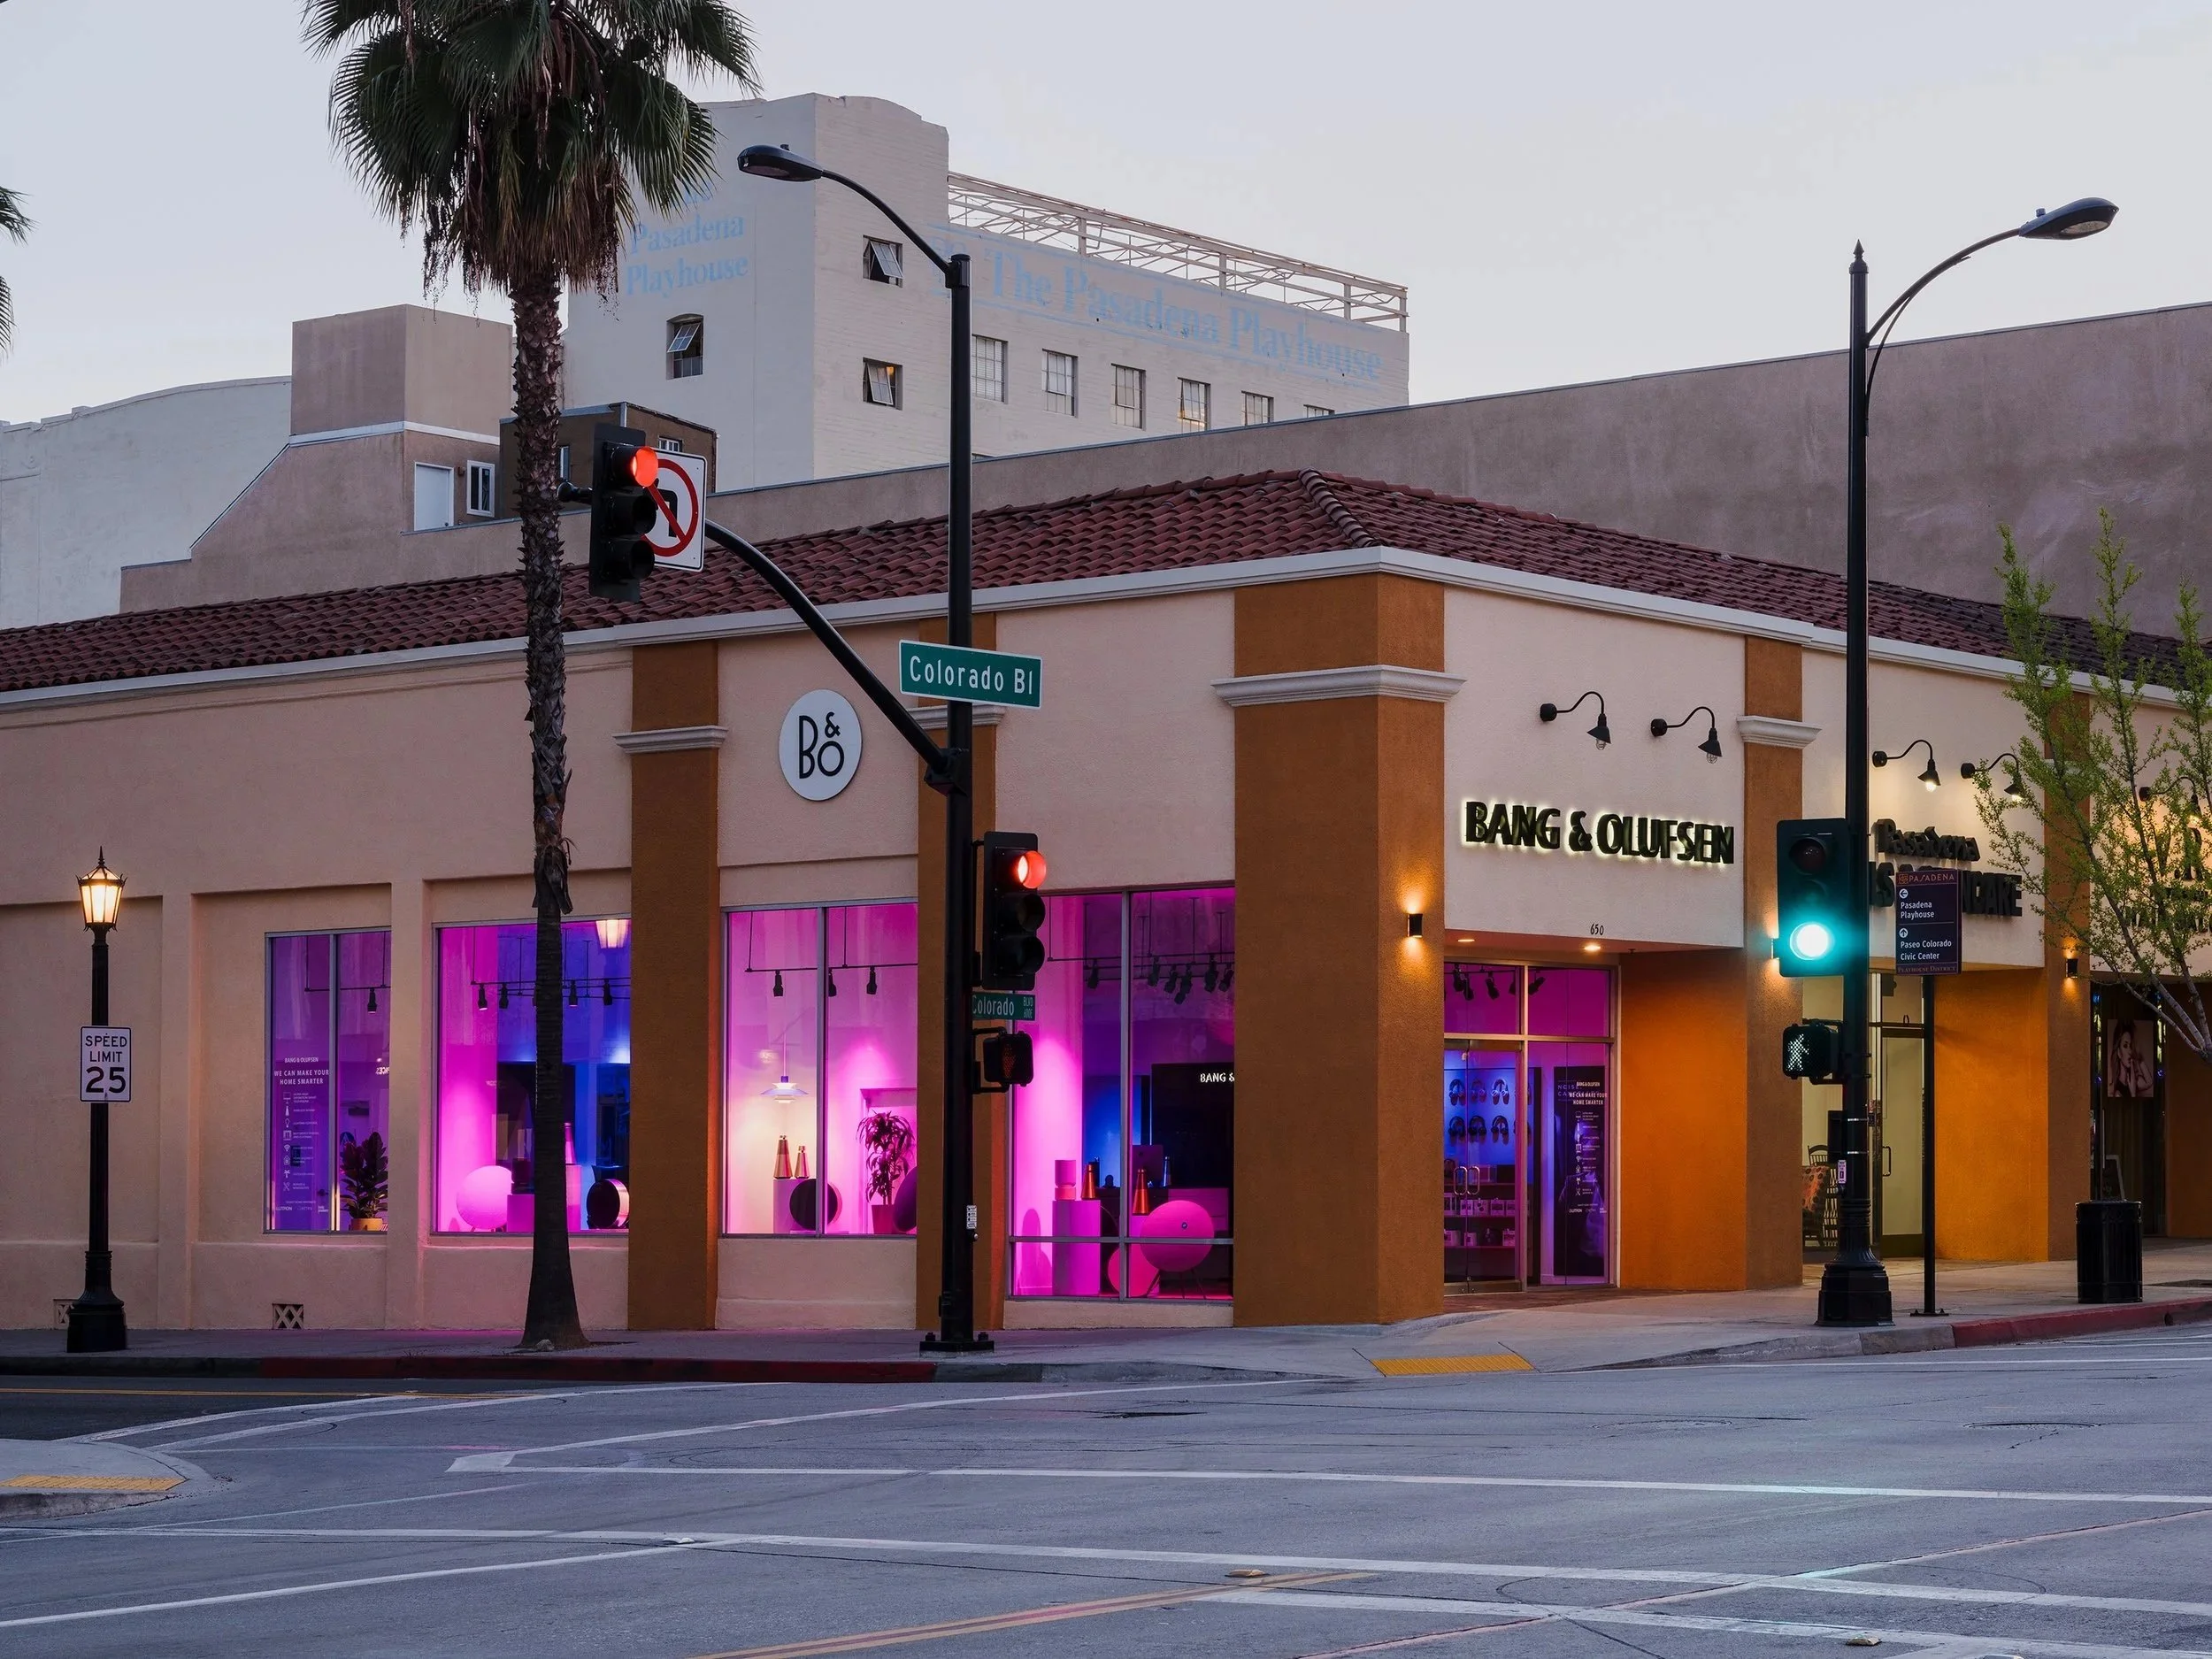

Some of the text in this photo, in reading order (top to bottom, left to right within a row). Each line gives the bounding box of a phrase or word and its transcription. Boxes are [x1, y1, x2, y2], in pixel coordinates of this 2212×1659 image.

[630, 213, 745, 256] Pasadena
[626, 256, 749, 298] Playhouse
[984, 246, 1052, 305] The
[1063, 264, 1220, 344] Pasadena
[1227, 306, 1385, 382] Playhouse
[910, 656, 1033, 695] Colorado Bl
[1465, 801, 1735, 864] BANG & OLUFSEN
[1871, 818, 1981, 862] Pasadena
[1909, 872, 1955, 883] PASADENA
[1901, 900, 1932, 910] Pasadena
[1901, 910, 1935, 921] Playhouse
[1590, 923, 1604, 936] 650
[1901, 939, 1952, 949] Paseo Colorado
[1901, 951, 1940, 961] Civic Center
[972, 995, 1033, 1017] Colorado BLVD
[85, 1035, 127, 1048] SPEED
[89, 1050, 123, 1062] LIMIT
[86, 1066, 127, 1094] 25
[1200, 1071, 1235, 1083] BANG &
